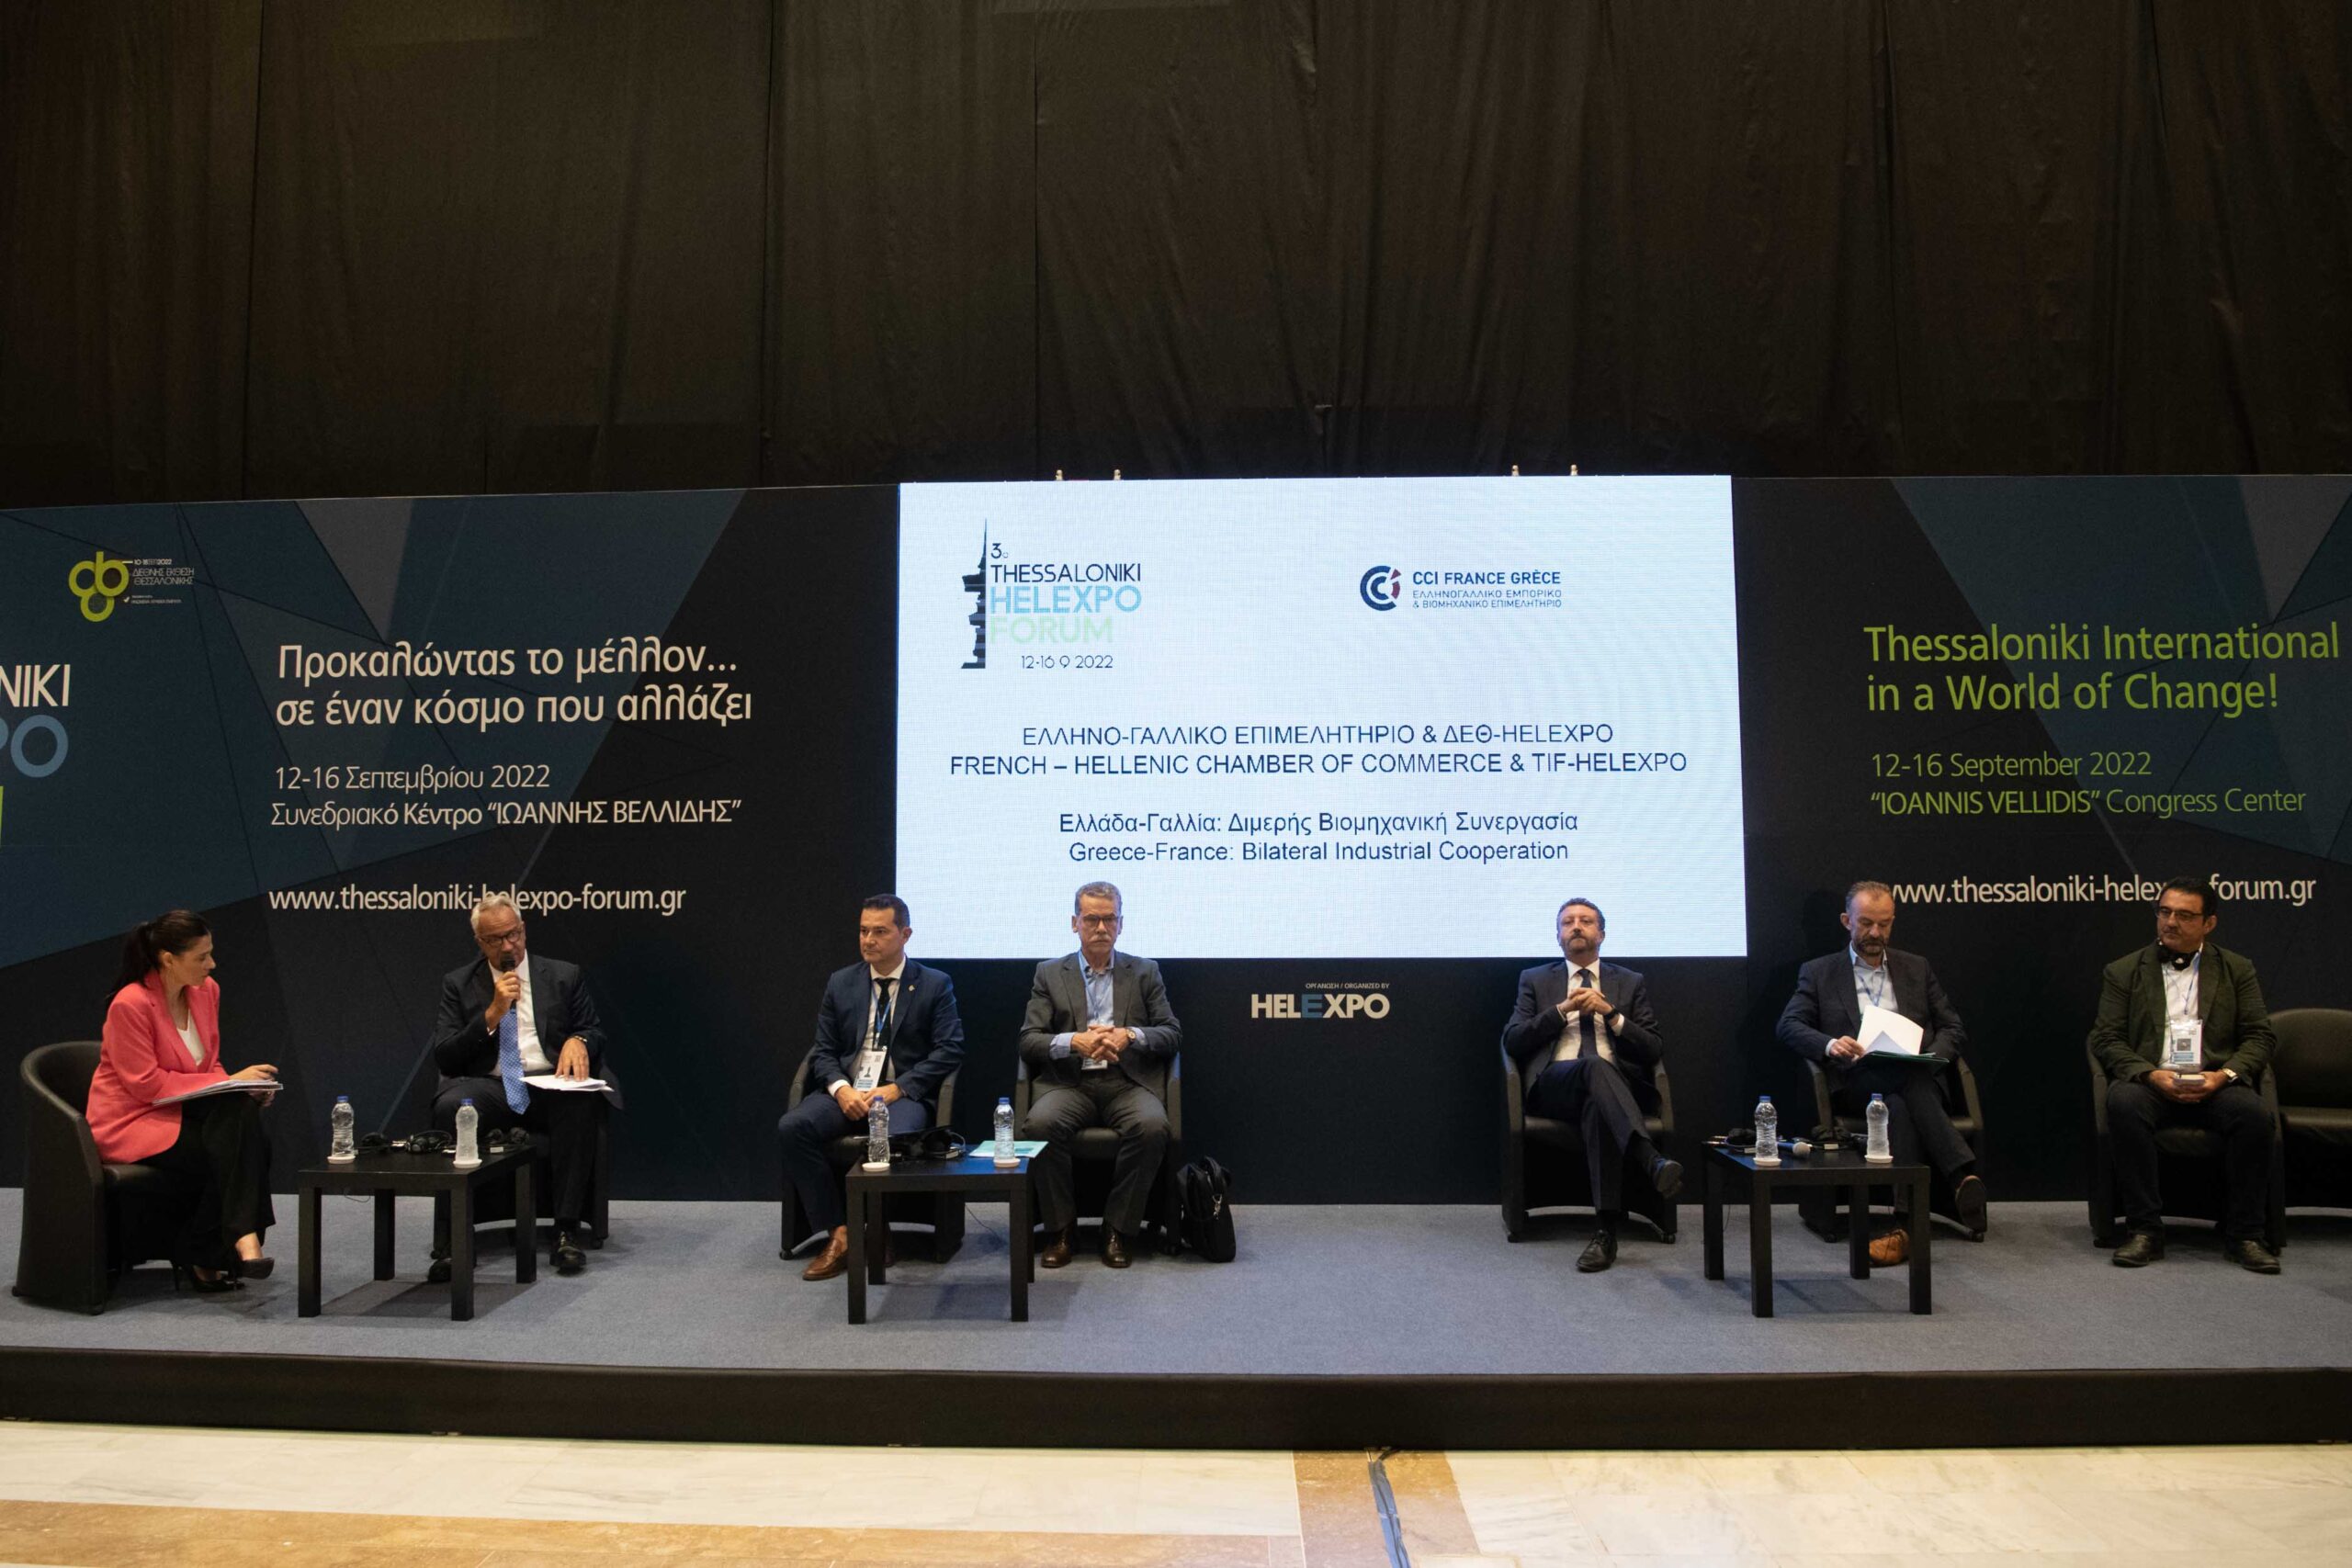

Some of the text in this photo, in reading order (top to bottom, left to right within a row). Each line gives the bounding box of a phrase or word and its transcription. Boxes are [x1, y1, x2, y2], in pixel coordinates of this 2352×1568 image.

[989, 563, 1142, 583] THESSALONIKI
[1412, 570, 1562, 585] CCI FRANCE GRÈCE
[989, 584, 1143, 614] HELEXPO
[1412, 590, 1562, 599] ΕΛΛΗΝΟΓΑΛΛΙΚΟ ΕΜΠΟΡΙΚΟ
[1422, 600, 1488, 609] ΒΙΟΜΗΧΑΝΙΚΟ
[1490, 599, 1562, 608] ΕΠΙΜΕΛΗΤΗΡΙΟ
[989, 615, 1114, 644] FORUM
[1863, 621, 2339, 662] Thessaloniki International
[278, 635, 737, 687] Προκαλώντας το μέλλον...
[1075, 654, 1114, 669] 2022
[276, 682, 752, 733] σε έναν κόσμο που αλλάζει
[1868, 671, 2278, 718] in a World of Change!
[1023, 723, 1613, 746] ΕΛΛΗΝΟ-ΓΑΛΛΙΚΟ ΕΠΙΜΕΛΗΤΗΡΙΟ & ΔΕΘ-HELEXPO
[950, 755, 1046, 775] FRENCH
[1074, 754, 1189, 775] HELLENIC
[1195, 753, 1316, 774] CHAMBER
[1321, 753, 1354, 773] OF
[1361, 752, 1503, 773] COMMERCE
[1510, 752, 1526, 773] &
[1531, 751, 1688, 773] TIF-HELEXPO
[1871, 750, 2152, 783] 12-16 September 2022
[275, 763, 550, 795] 12-16 Σεπτεμβρίου 2022
[270, 798, 742, 831] Συνεδριακό Κέντρο “ΙΩΑΝΝΗΣ ΒΕΛΛΙΔΗΣ”
[1871, 787, 2307, 819] “IOANNIS VELLIDIS” Congress Center
[1059, 811, 1578, 836] Ελλάδα-Γαλλία: Διμερής Βιομηχανική Συνεργασία
[1069, 840, 1568, 865] Greece-France: Bilateral Industrial Cooperation
[1250, 993, 1391, 1020] HELEXPO
